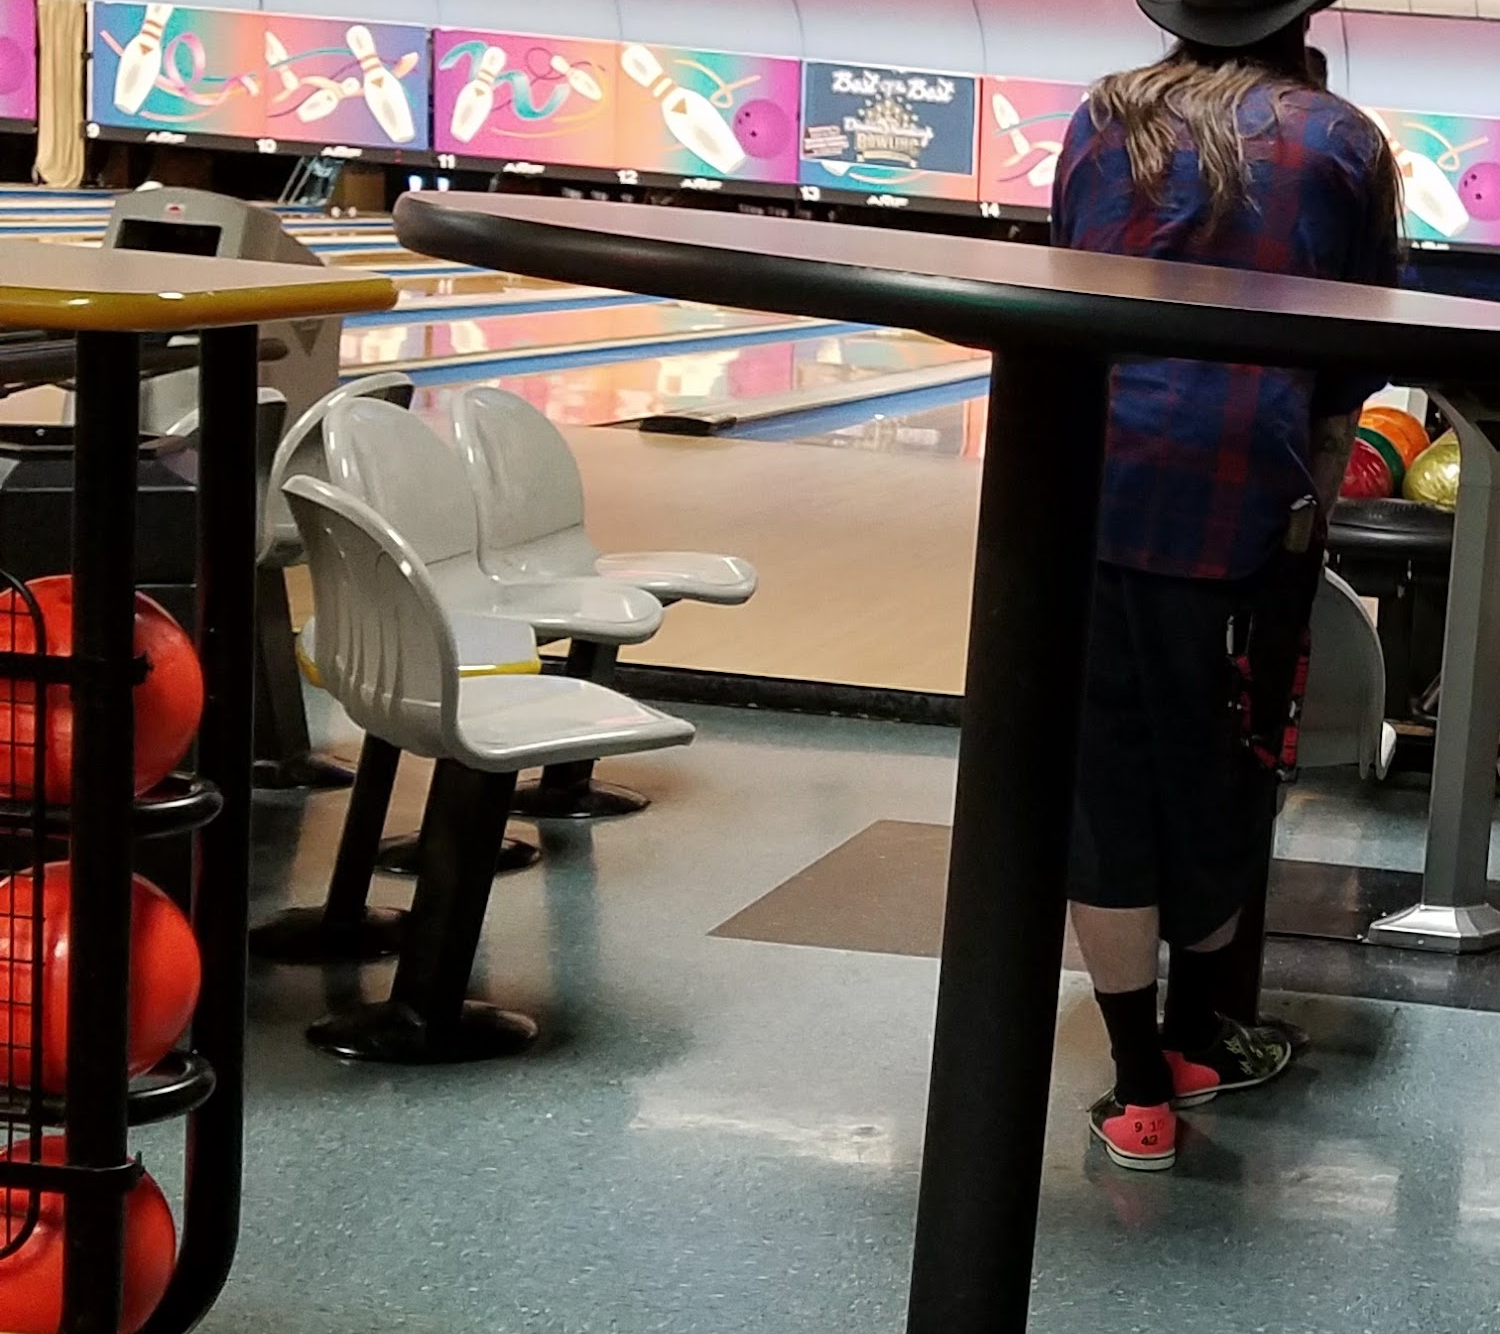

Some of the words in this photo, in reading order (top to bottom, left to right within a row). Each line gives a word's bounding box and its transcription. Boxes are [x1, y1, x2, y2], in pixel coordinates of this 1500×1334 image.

[256, 138, 277, 154] 10
[437, 154, 456, 169] 11
[616, 169, 639, 185] 12
[980, 202, 1001, 219] 14
[1134, 1121, 1143, 1134] 9
[1140, 1134, 1158, 1147] 42
